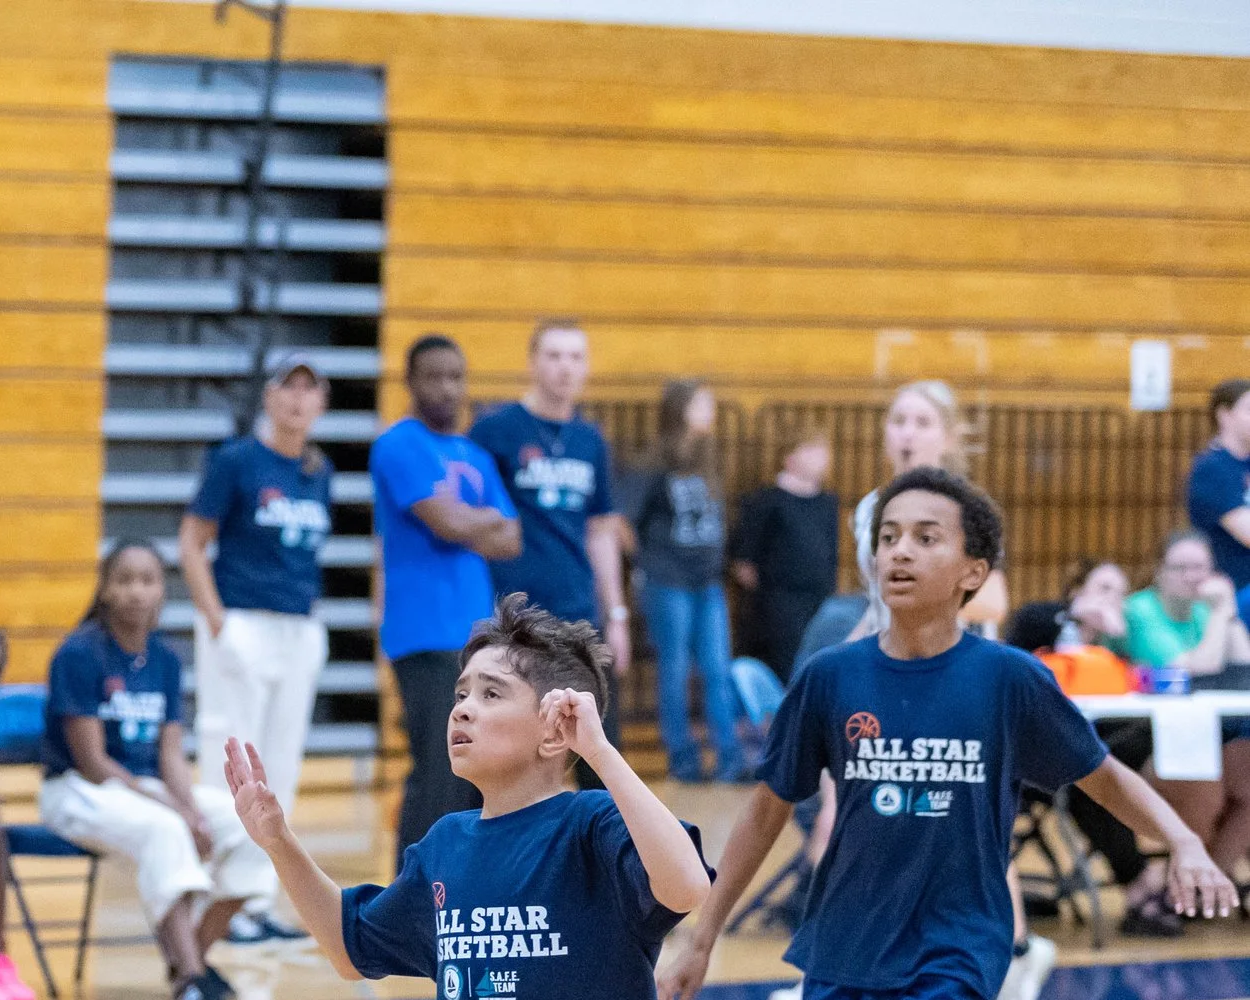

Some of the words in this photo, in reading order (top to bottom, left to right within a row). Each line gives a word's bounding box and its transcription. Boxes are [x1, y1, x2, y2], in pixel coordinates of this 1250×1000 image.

[857, 738, 908, 760] ALL
[912, 738, 982, 761] STAR
[844, 760, 986, 783] BASKETBALL
[470, 906, 549, 932] STAR
[438, 933, 568, 962] SKETBALL
[489, 971, 520, 981] S.A.F.E.
[493, 982, 516, 992] TEAM
